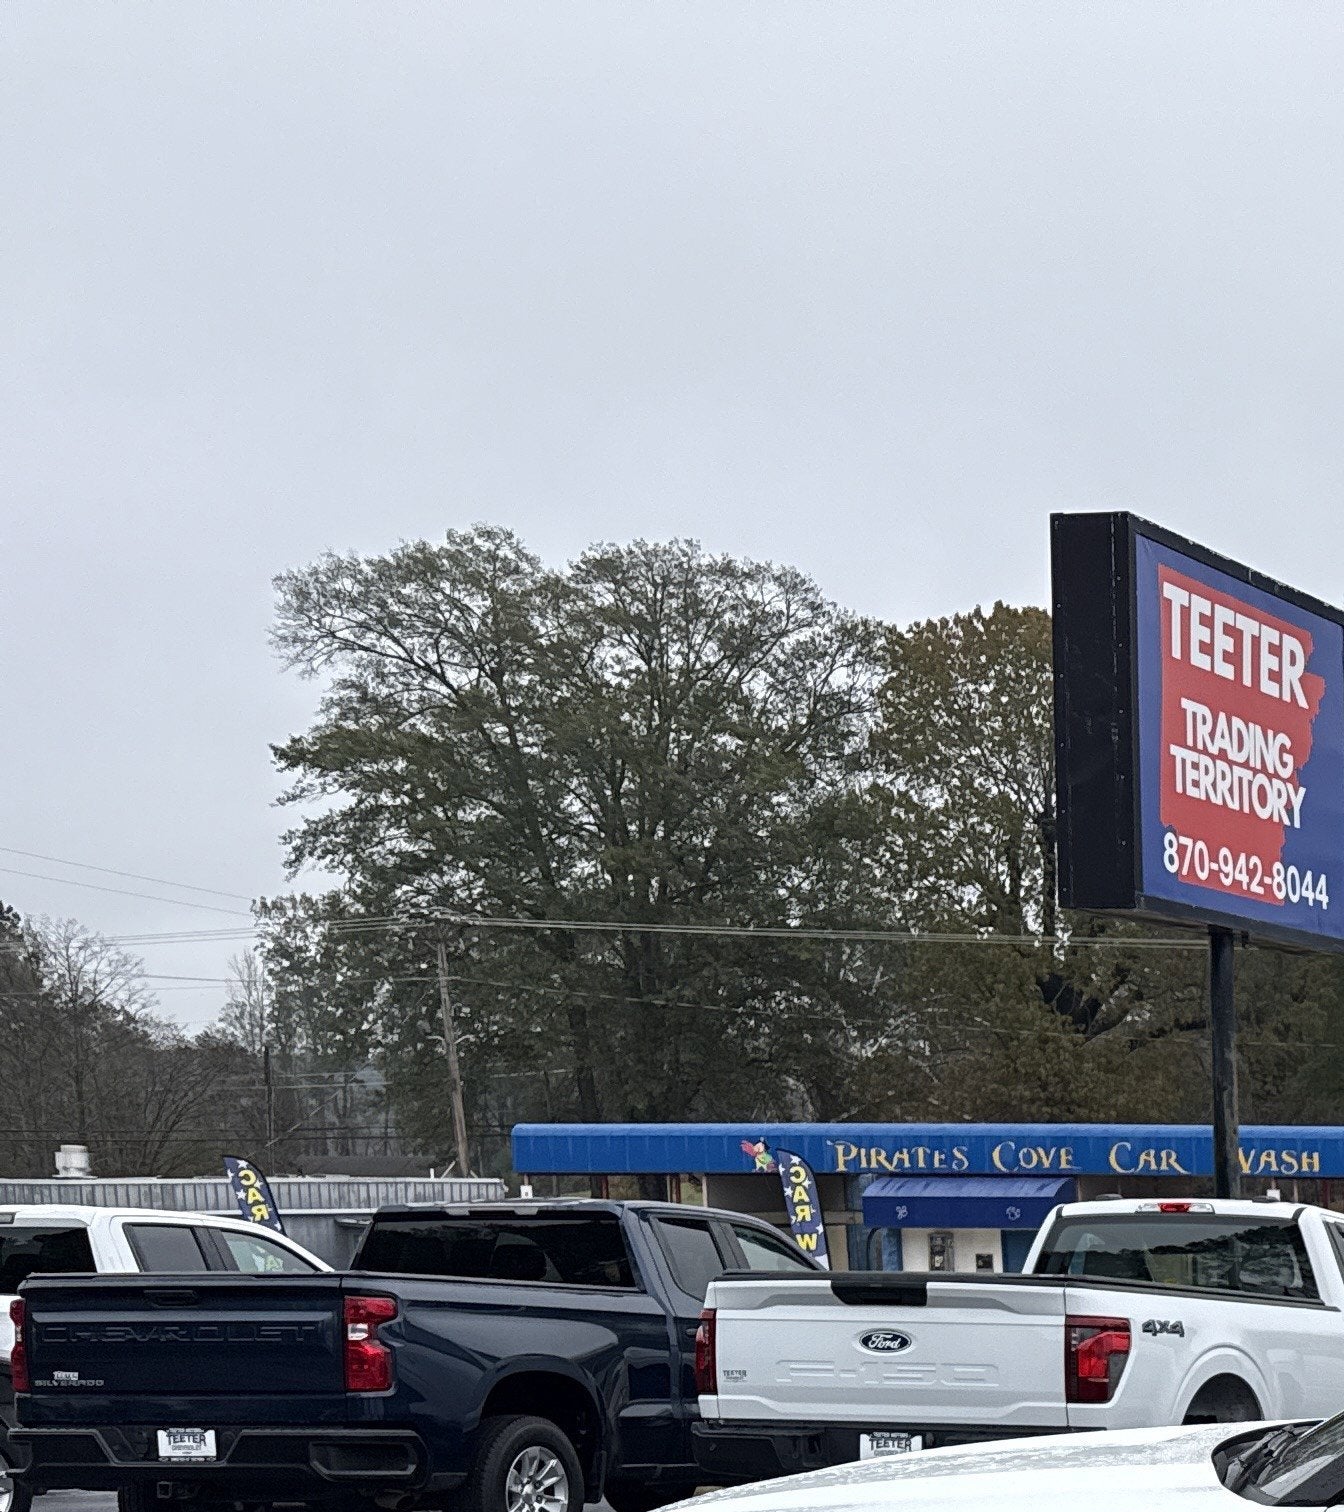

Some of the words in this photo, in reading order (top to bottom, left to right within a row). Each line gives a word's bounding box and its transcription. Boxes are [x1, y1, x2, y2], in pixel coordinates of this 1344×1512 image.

[1162, 581, 1309, 710] TEETER
[1180, 697, 1294, 777] TRADING
[1169, 744, 1306, 829] TERRITORY
[1163, 831, 1329, 910] 870-942-8044
[992, 1141, 1077, 1173] COVE
[1108, 1141, 1191, 1175] CAR
[42, 1326, 317, 1342] CHEVROLET
[868, 1332, 902, 1350] Ford
[34, 1379, 105, 1388] SILVERADO
[166, 1433, 207, 1446] TEETER
[869, 1437, 912, 1452] TEETER
